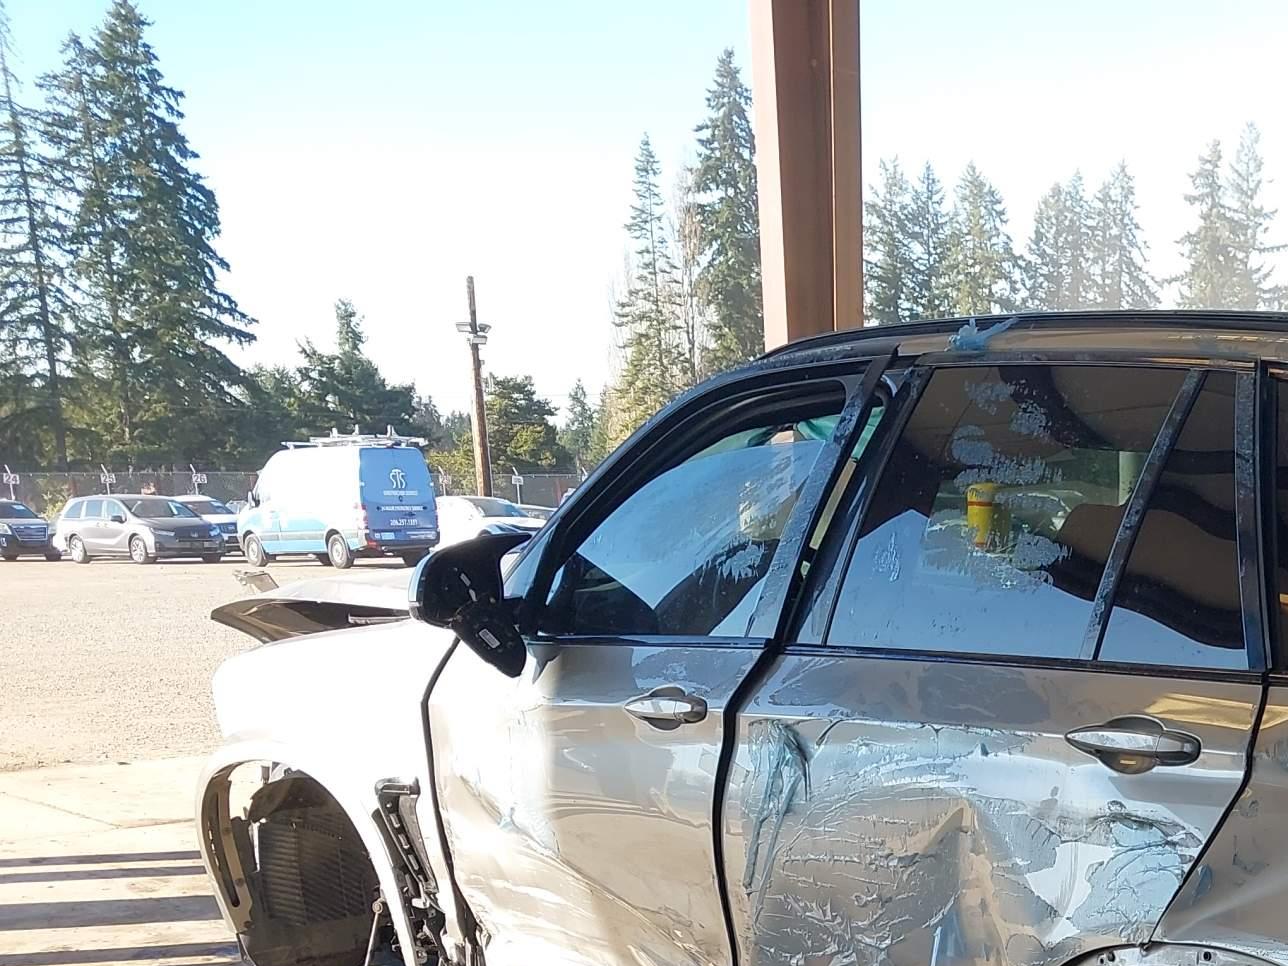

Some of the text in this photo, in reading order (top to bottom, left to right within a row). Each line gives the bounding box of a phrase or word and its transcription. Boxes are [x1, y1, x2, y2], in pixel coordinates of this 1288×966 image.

[102, 474, 115, 483] 25
[194, 474, 206, 483] 26
[389, 468, 406, 489] STS
